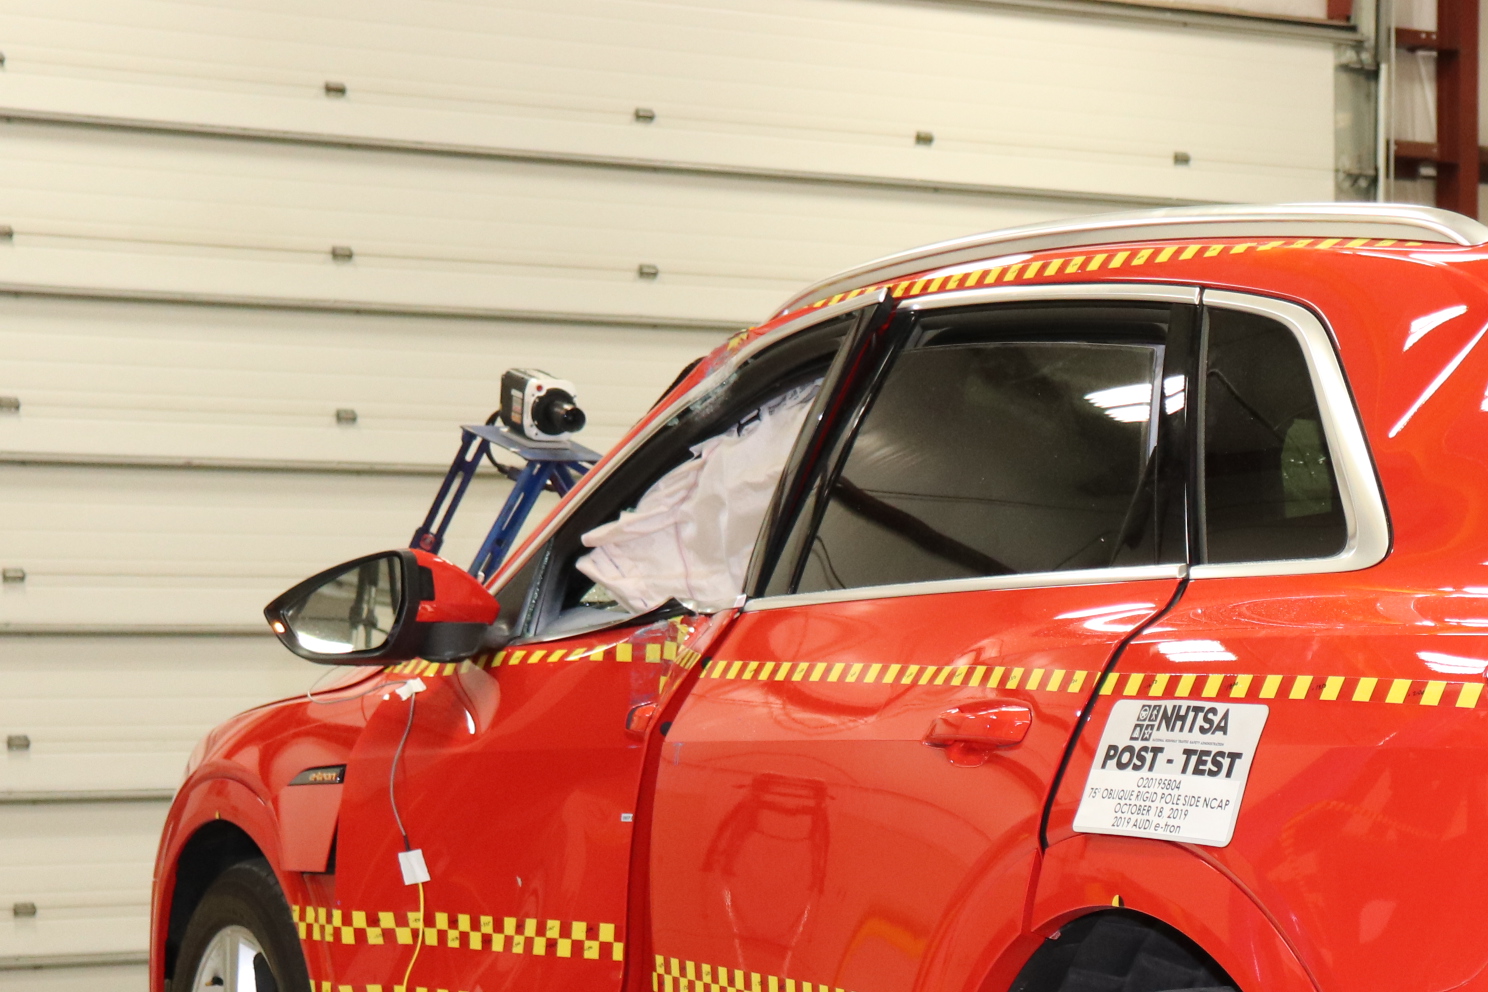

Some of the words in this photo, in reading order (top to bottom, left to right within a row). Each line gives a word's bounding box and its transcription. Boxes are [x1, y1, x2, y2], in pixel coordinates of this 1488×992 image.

[1156, 705, 1230, 736] NHTSA
[1101, 744, 1165, 772] POST
[1181, 748, 1243, 778] TEST
[1101, 788, 1135, 801] OBLIQUE
[1135, 790, 1158, 803] RIGID
[1159, 792, 1181, 805] POLE
[1182, 794, 1201, 808] SIDE
[1202, 797, 1230, 811] NCAP
[1114, 802, 1152, 816] OCTOBER
[1153, 806, 1164, 819] 18,
[1167, 807, 1189, 821] 2019
[1111, 816, 1131, 828] 2019
[1131, 818, 1153, 831] AUDI
[1153, 821, 1181, 834] e-tron
